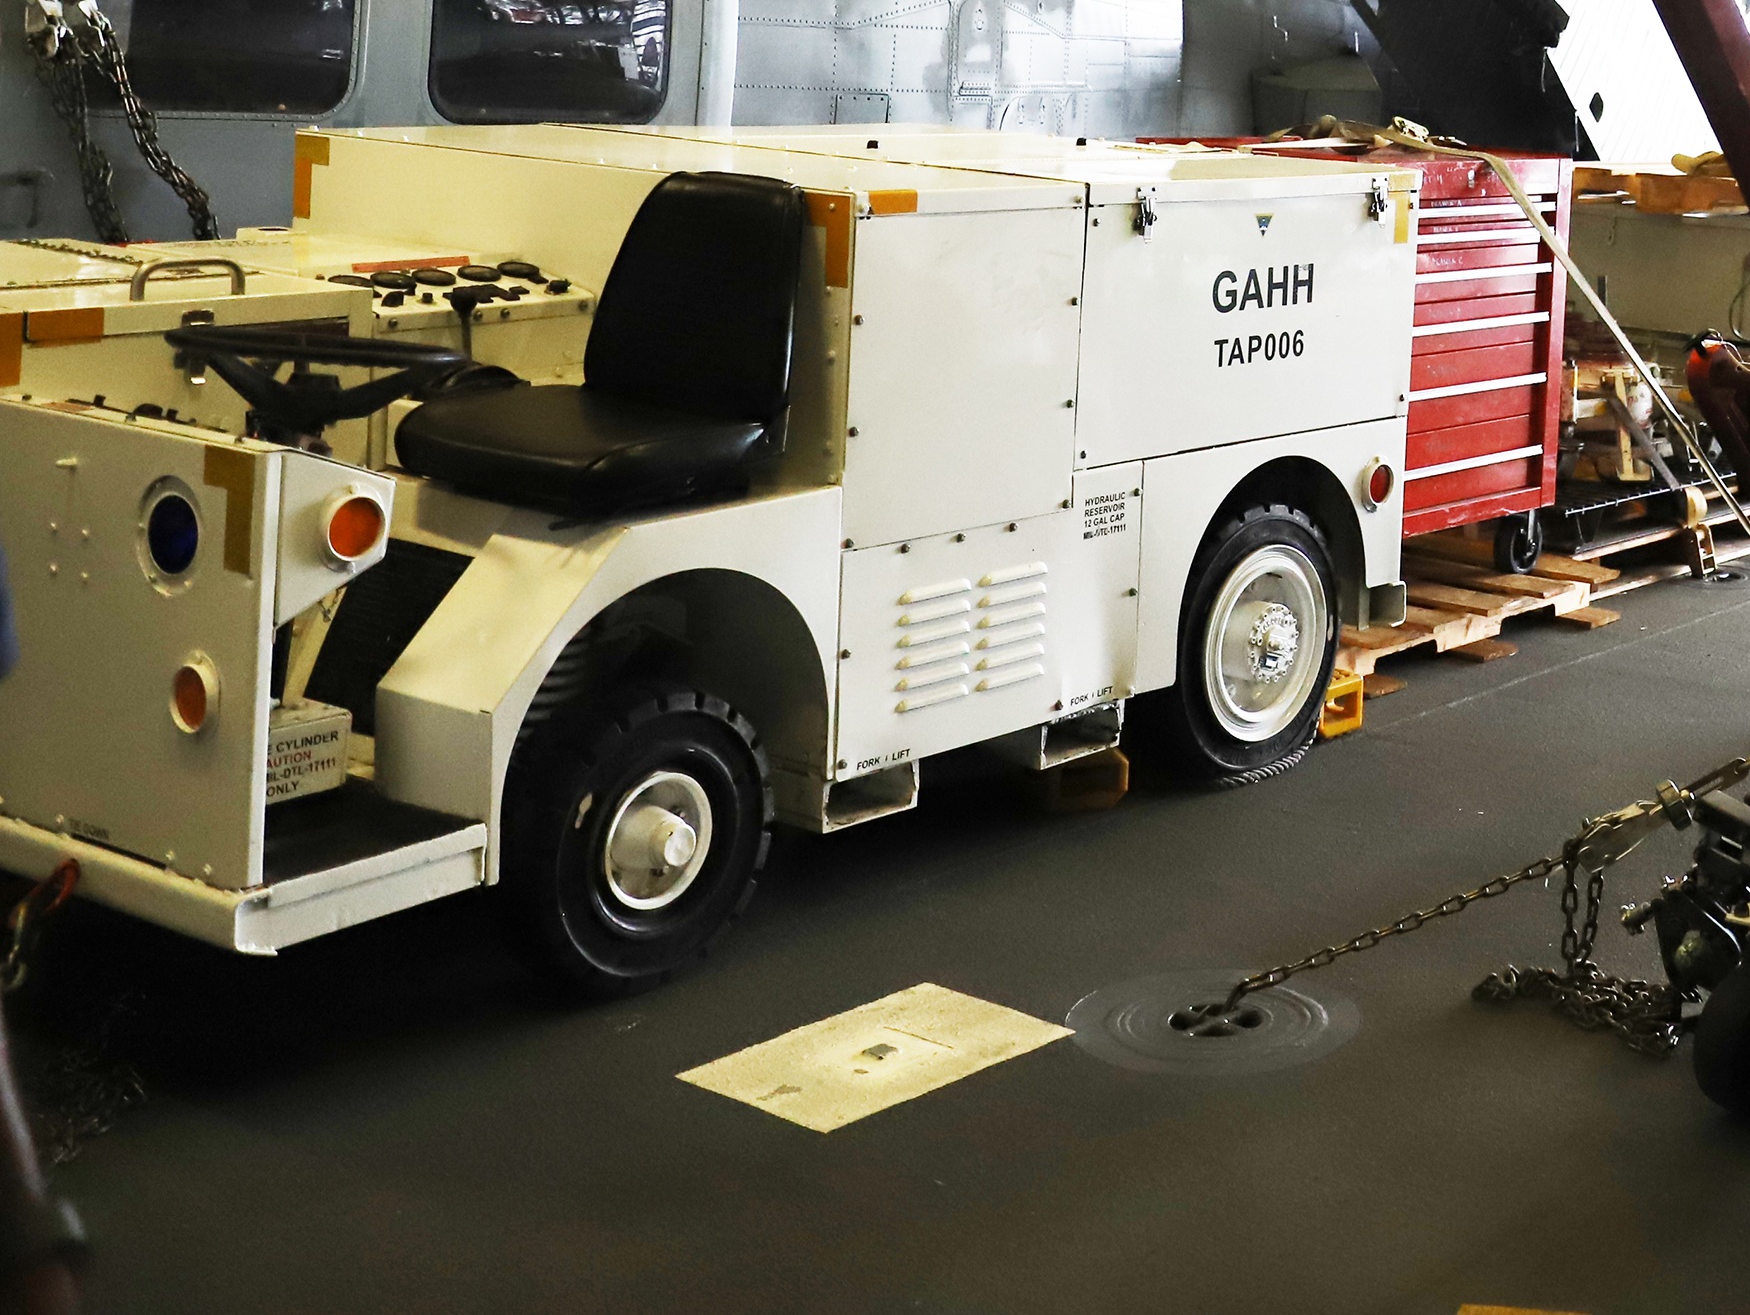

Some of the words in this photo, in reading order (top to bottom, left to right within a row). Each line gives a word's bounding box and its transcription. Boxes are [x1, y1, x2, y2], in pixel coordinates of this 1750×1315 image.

[1212, 263, 1314, 313] GAHH
[1214, 330, 1304, 367] TAP006
[1085, 492, 1126, 507] HYDRAULIC
[1084, 502, 1125, 517] RESERVOIR
[1084, 519, 1092, 527] 12
[1093, 516, 1108, 525] GAL
[1110, 513, 1125, 523] CAP
[1070, 693, 1088, 706] FORK
[1096, 686, 1113, 697] LIFT
[276, 730, 339, 753] CYLINDER
[267, 750, 312, 769] AUTION
[856, 756, 880, 770] FORK
[892, 748, 911, 761] LIFT
[266, 781, 299, 797] ONLY
